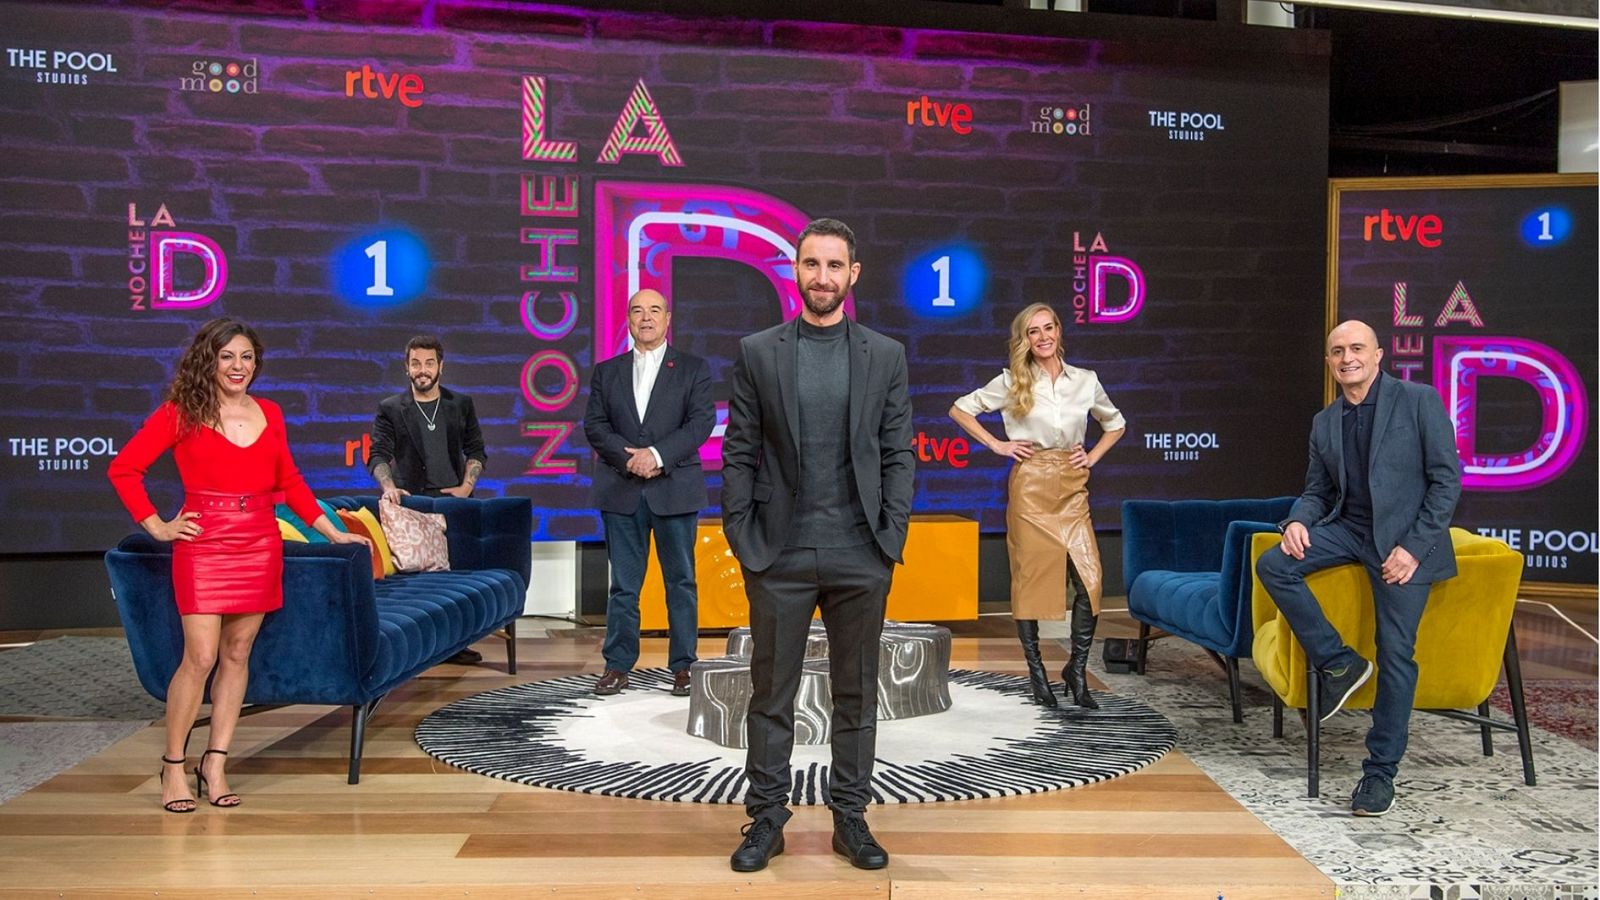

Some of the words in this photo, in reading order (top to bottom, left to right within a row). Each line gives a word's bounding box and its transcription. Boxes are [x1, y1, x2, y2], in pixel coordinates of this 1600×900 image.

[7, 48, 46, 69] THE
[53, 51, 117, 73] POOL
[37, 72, 88, 85] STUDIOS
[345, 64, 424, 107] rtve
[521, 75, 685, 167] LA
[906, 95, 973, 135] rtve
[1149, 111, 1176, 127] THE
[1181, 113, 1224, 130] POOL
[1168, 130, 1204, 141] STUDIOS
[128, 202, 176, 227] LA
[1363, 208, 1443, 248] rtve
[1538, 212, 1553, 240] 1
[1073, 231, 1109, 252] LA
[128, 230, 146, 311] NOCHE
[150, 231, 228, 310] D
[364, 240, 394, 296] 1
[931, 256, 955, 307] 1
[1073, 255, 1086, 324] NOCHE
[1089, 256, 1146, 323] D
[1393, 281, 1484, 328] LA
[520, 174, 578, 475] NOCHE
[1432, 336, 1588, 492] D
[9, 438, 48, 456] THE
[56, 437, 118, 456] POOL
[345, 433, 373, 466] rt
[912, 432, 969, 468] tve
[1144, 433, 1172, 449] THE
[1176, 433, 1220, 449] POOL
[1164, 451, 1200, 461] STUDIOS
[38, 459, 89, 471] STUDIOS
[1529, 530, 1599, 553] POOL
[1527, 554, 1567, 568] UDIOS
